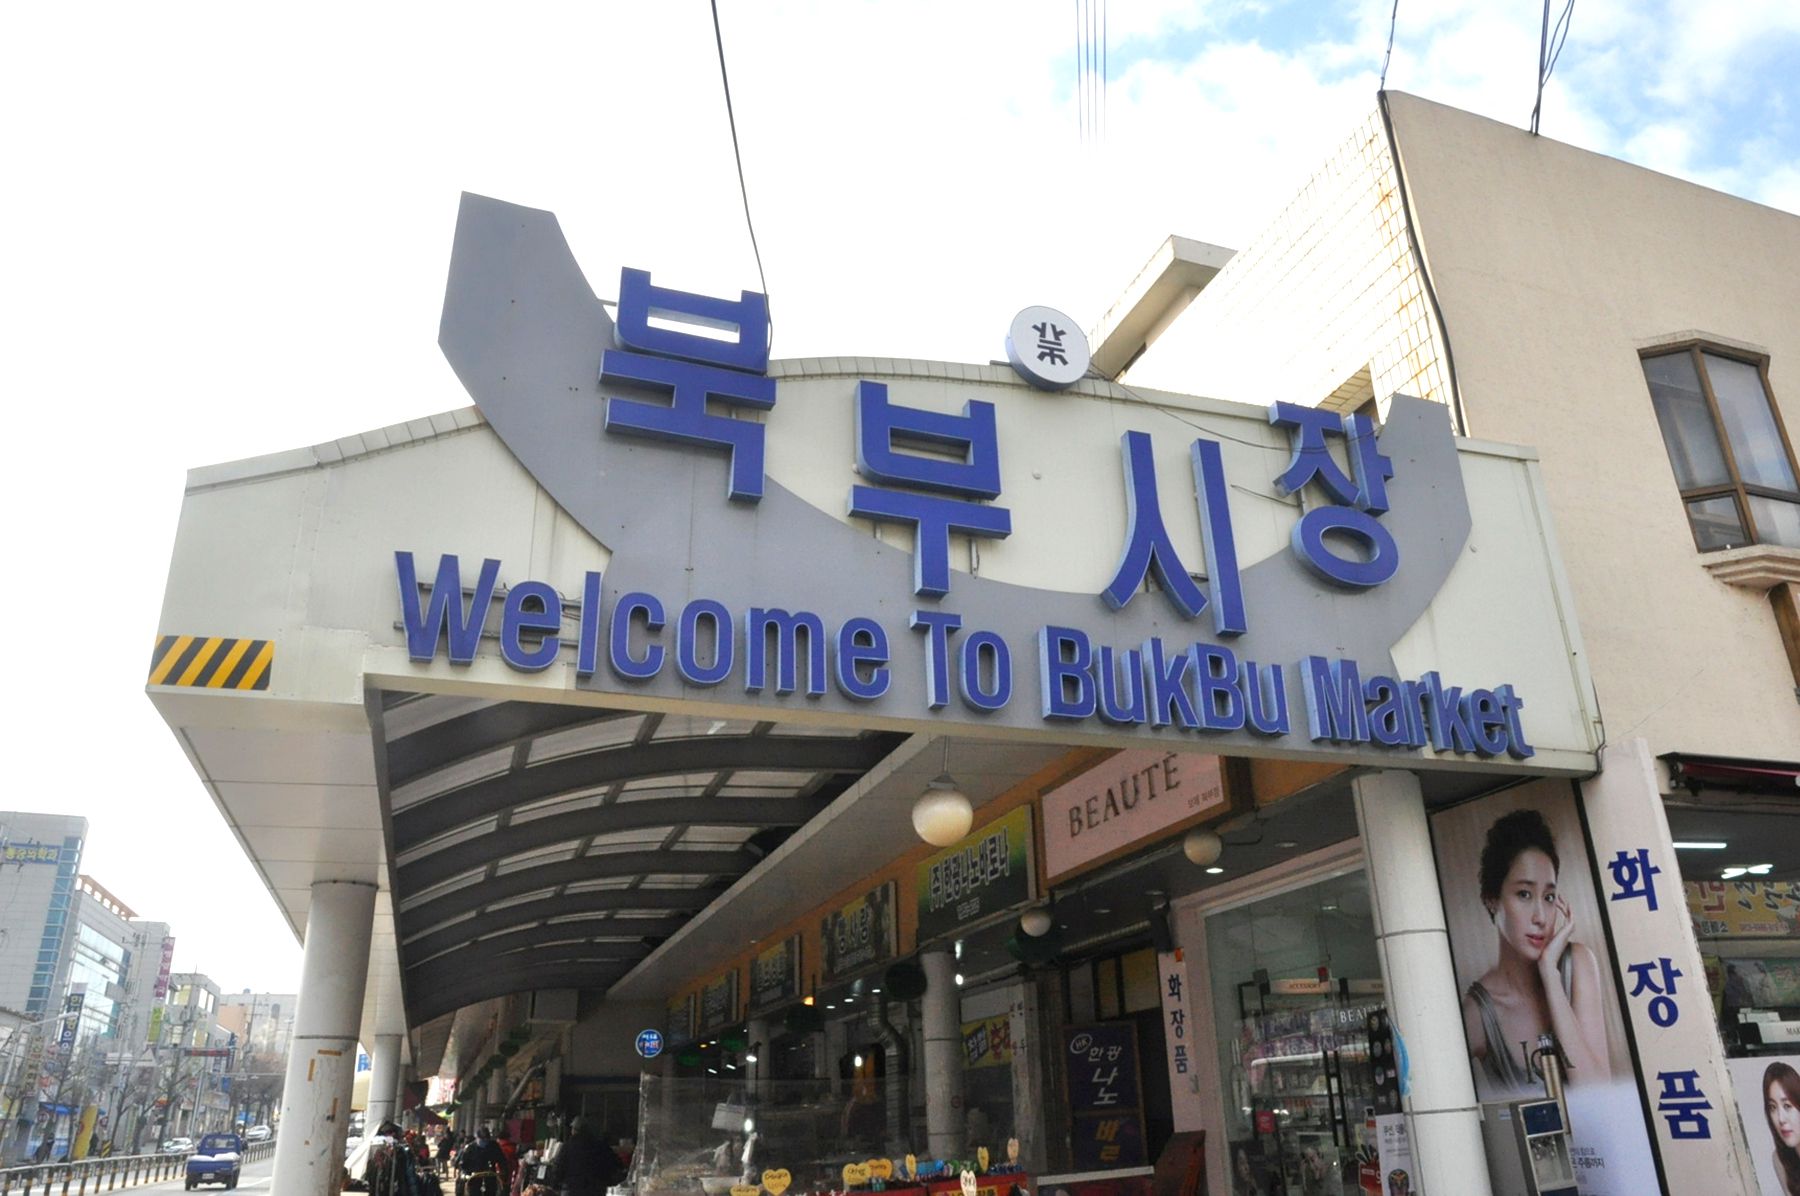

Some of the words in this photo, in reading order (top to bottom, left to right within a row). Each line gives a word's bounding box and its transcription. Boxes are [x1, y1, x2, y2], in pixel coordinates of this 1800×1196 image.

[600, 267, 1399, 637] 북부시장
[394, 551, 891, 702] Welcome
[910, 610, 1012, 712] To
[1039, 625, 1289, 737] BukBu
[1300, 655, 1534, 759] Market
[1168, 974, 1188, 1074] 화장품
[1607, 848, 1713, 1140] 화장품
